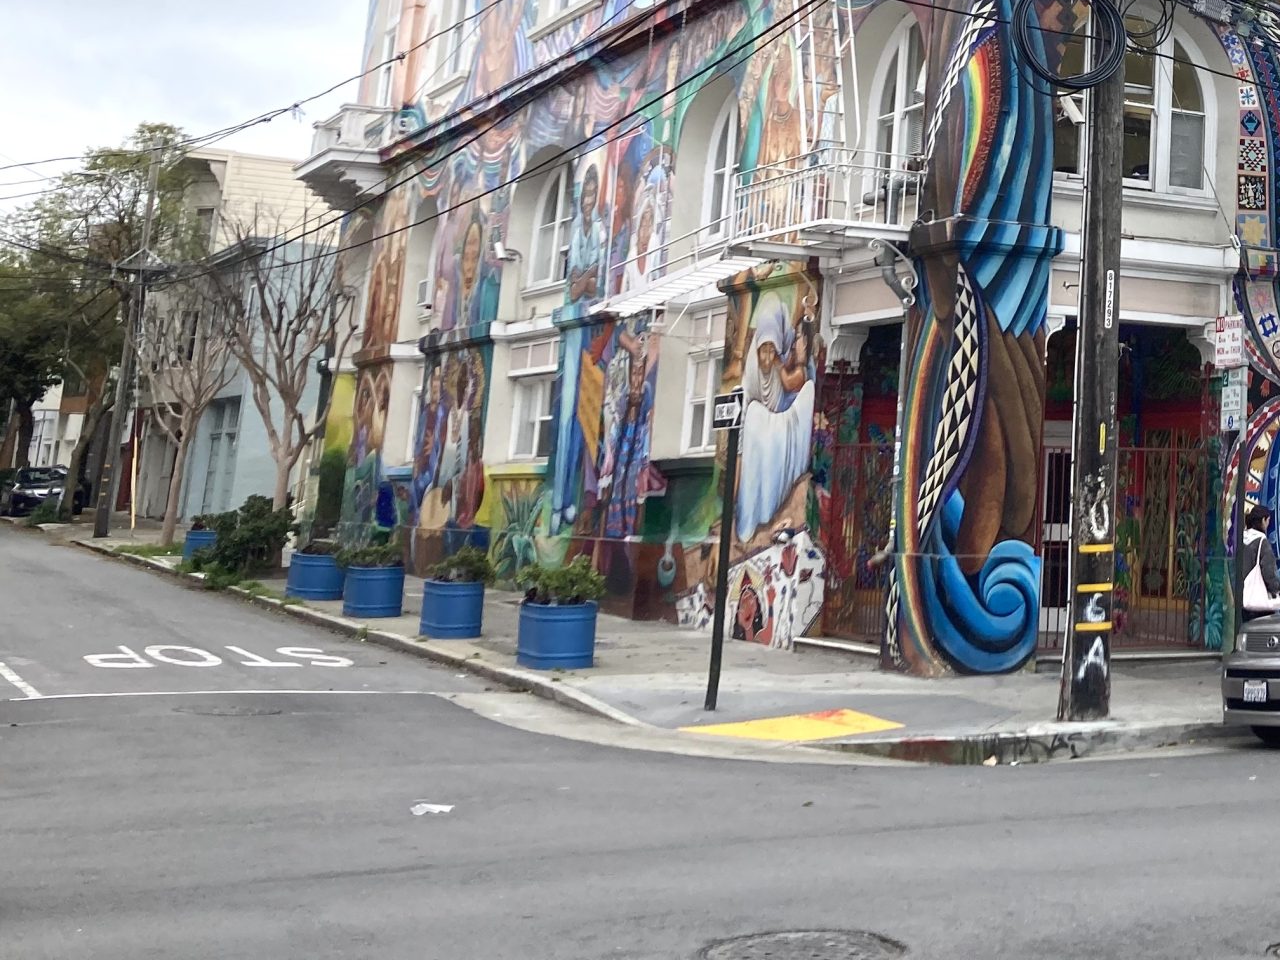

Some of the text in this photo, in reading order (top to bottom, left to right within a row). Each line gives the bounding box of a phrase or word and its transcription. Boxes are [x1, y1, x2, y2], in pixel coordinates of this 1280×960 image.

[1106, 272, 1114, 327] 817293
[1216, 317, 1243, 332] NO PARKING
[1223, 372, 1228, 385] 2
[716, 405, 725, 419] ONE
[83, 644, 355, 668] STOP
